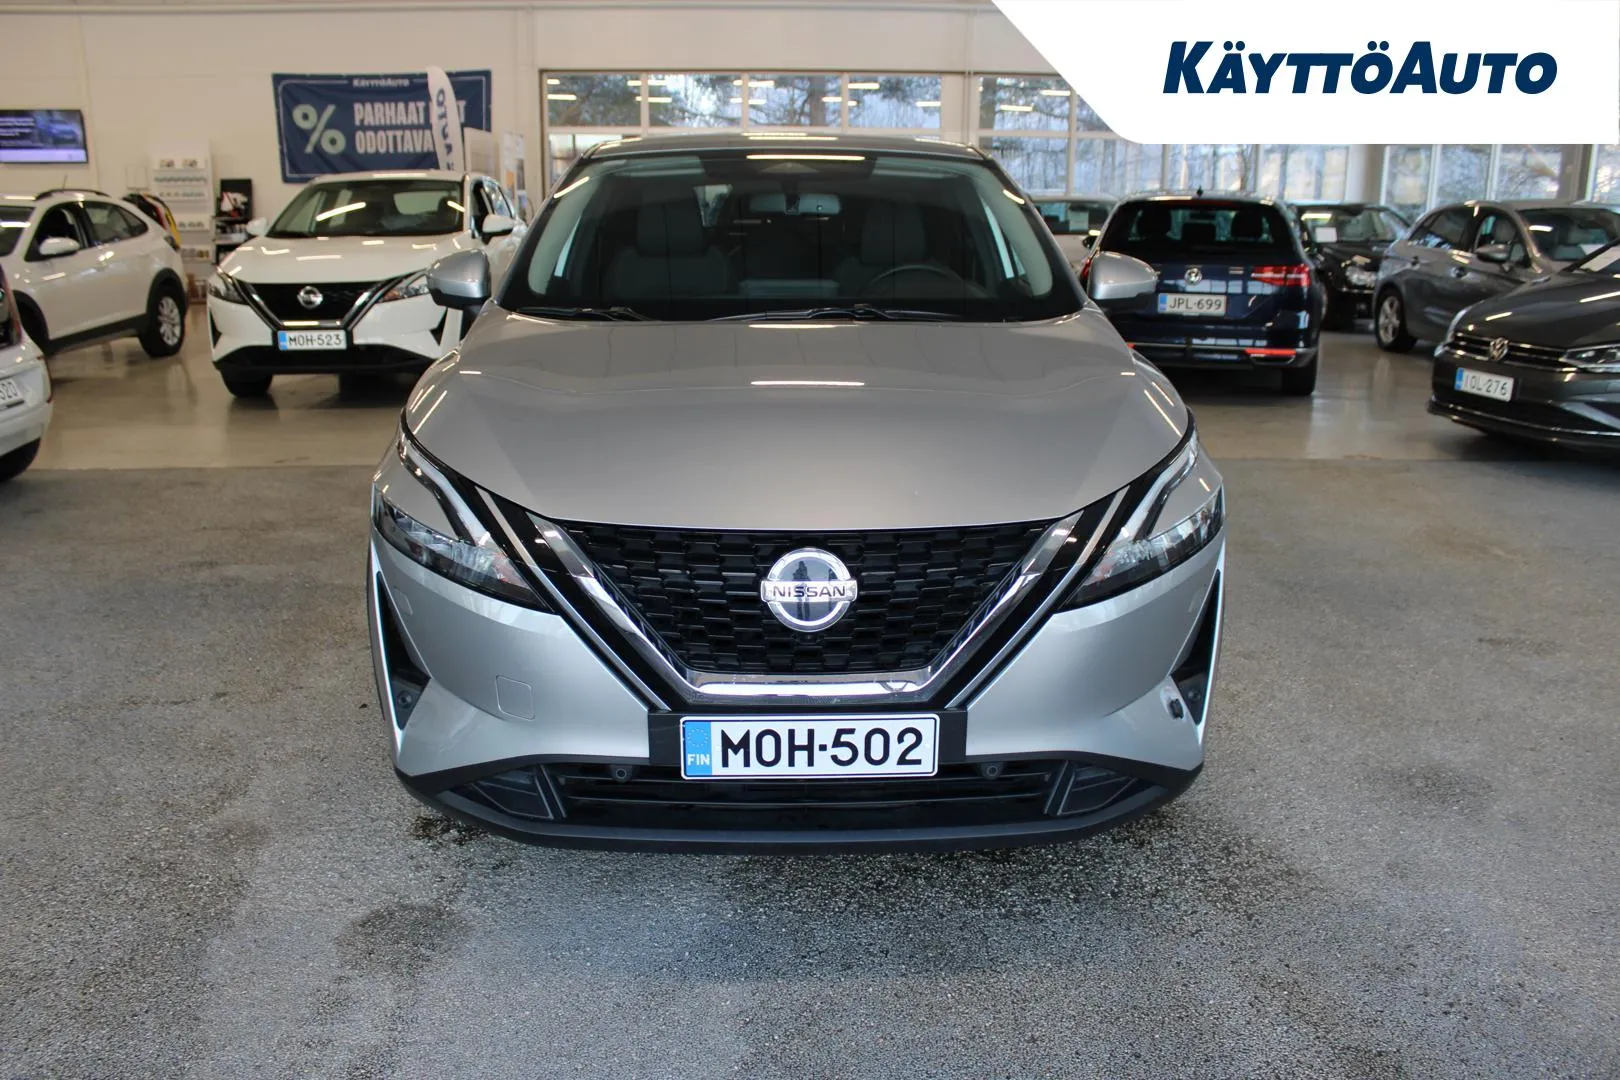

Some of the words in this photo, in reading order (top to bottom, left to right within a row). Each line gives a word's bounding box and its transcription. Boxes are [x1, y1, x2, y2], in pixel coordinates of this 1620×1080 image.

[353, 101, 426, 126] PARHAAT
[355, 129, 437, 154] ODOTTAVA
[1169, 297, 1222, 310] JPL-699
[288, 333, 341, 346] MOH-523
[772, 585, 846, 598] NISSAN
[686, 753, 711, 767] FIN
[720, 726, 923, 768] MOH-502
